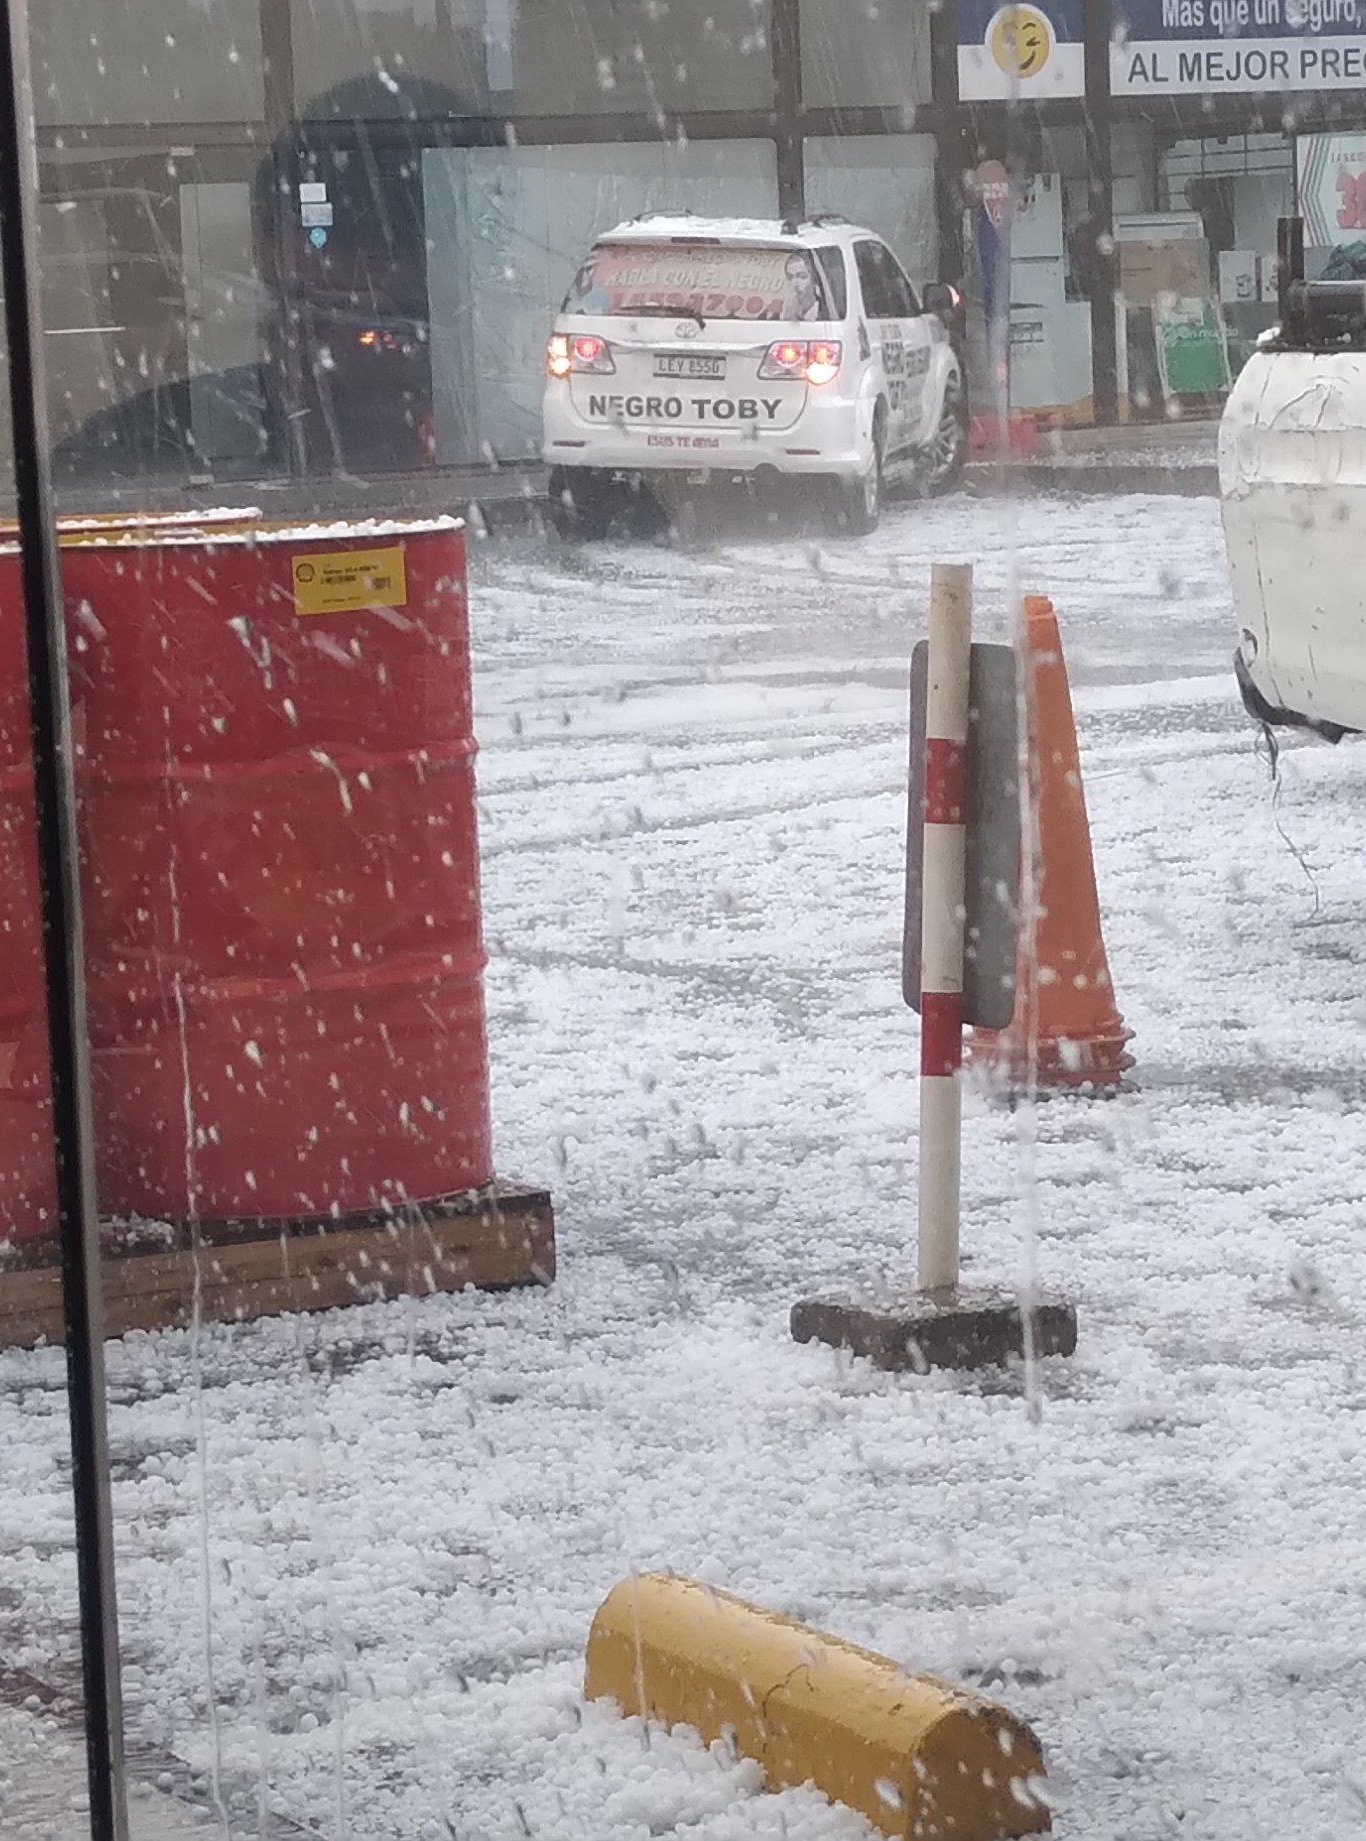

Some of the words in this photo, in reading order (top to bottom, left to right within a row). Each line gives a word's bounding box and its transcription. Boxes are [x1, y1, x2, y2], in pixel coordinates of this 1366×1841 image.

[1210, 0, 1248, 33] que
[1255, 0, 1280, 24] un
[1129, 52, 1169, 83] AL
[1178, 50, 1289, 82] MEJOR
[589, 395, 683, 417] NEGRO
[691, 398, 783, 420] TOBY
